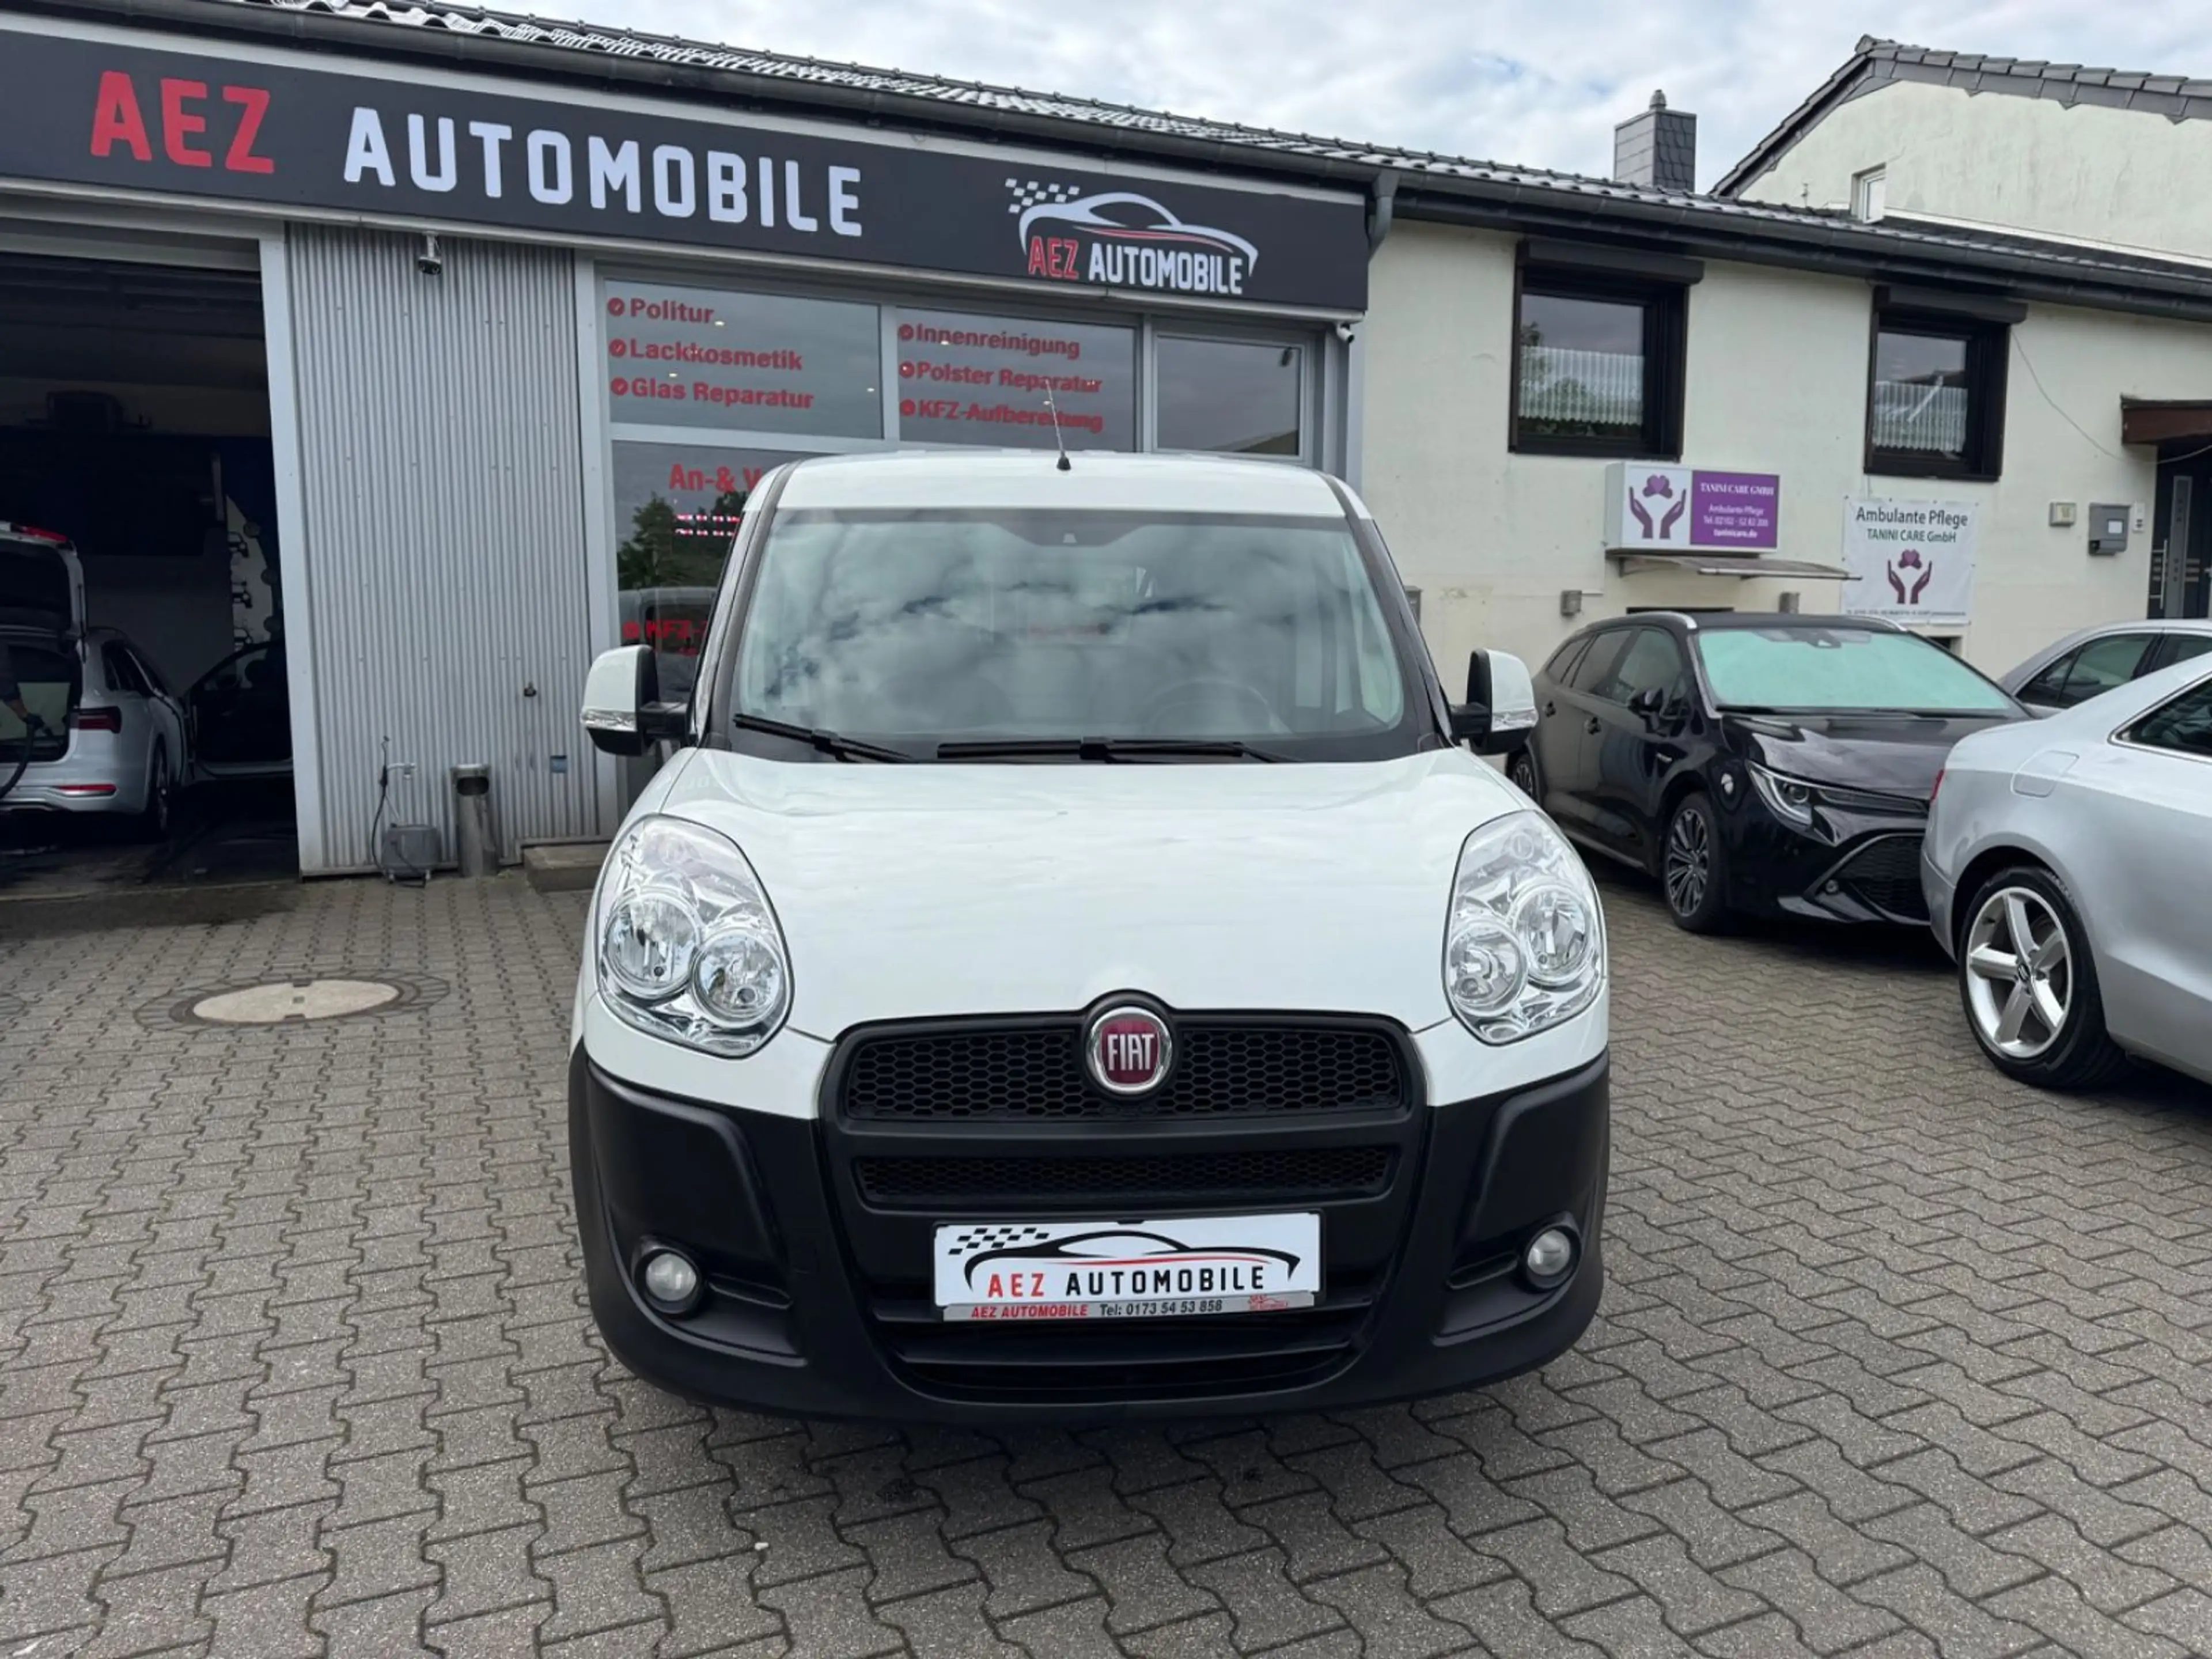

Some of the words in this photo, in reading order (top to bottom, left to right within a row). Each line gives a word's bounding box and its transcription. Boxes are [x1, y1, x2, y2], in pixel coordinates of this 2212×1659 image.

[90, 70, 275, 175] AEZ
[343, 106, 862, 236] AUTOMOBILE
[1028, 236, 1079, 279] AEZ
[1088, 243, 1243, 294] AUTOMOBILE
[630, 298, 714, 323] Politur
[630, 339, 802, 370] Lackkosmetik
[916, 324, 1081, 359] Innenreinigung
[631, 377, 686, 400] Glas
[694, 381, 815, 409] Reparatur
[917, 361, 994, 385] Polster
[999, 368, 1103, 393] Reparatur
[1856, 506, 1927, 525] Ambulante
[1929, 509, 1968, 529] Pflege
[1867, 528, 1899, 541] TANINI
[1900, 529, 1925, 542] CARE
[1927, 531, 1956, 543] GmbH
[1107, 1033, 1155, 1071] FIAT
[988, 1273, 1045, 1298] AEZ
[1066, 1266, 1264, 1296] AUTOMOBILE
[971, 1305, 997, 1319] AEZ
[1001, 1304, 1088, 1317] AUTOMOBILE
[1100, 1304, 1122, 1316] Tel:
[1126, 1302, 1156, 1315] 0173
[1161, 1301, 1177, 1314] 54
[1180, 1301, 1196, 1313] 53
[1200, 1300, 1222, 1313] 858
